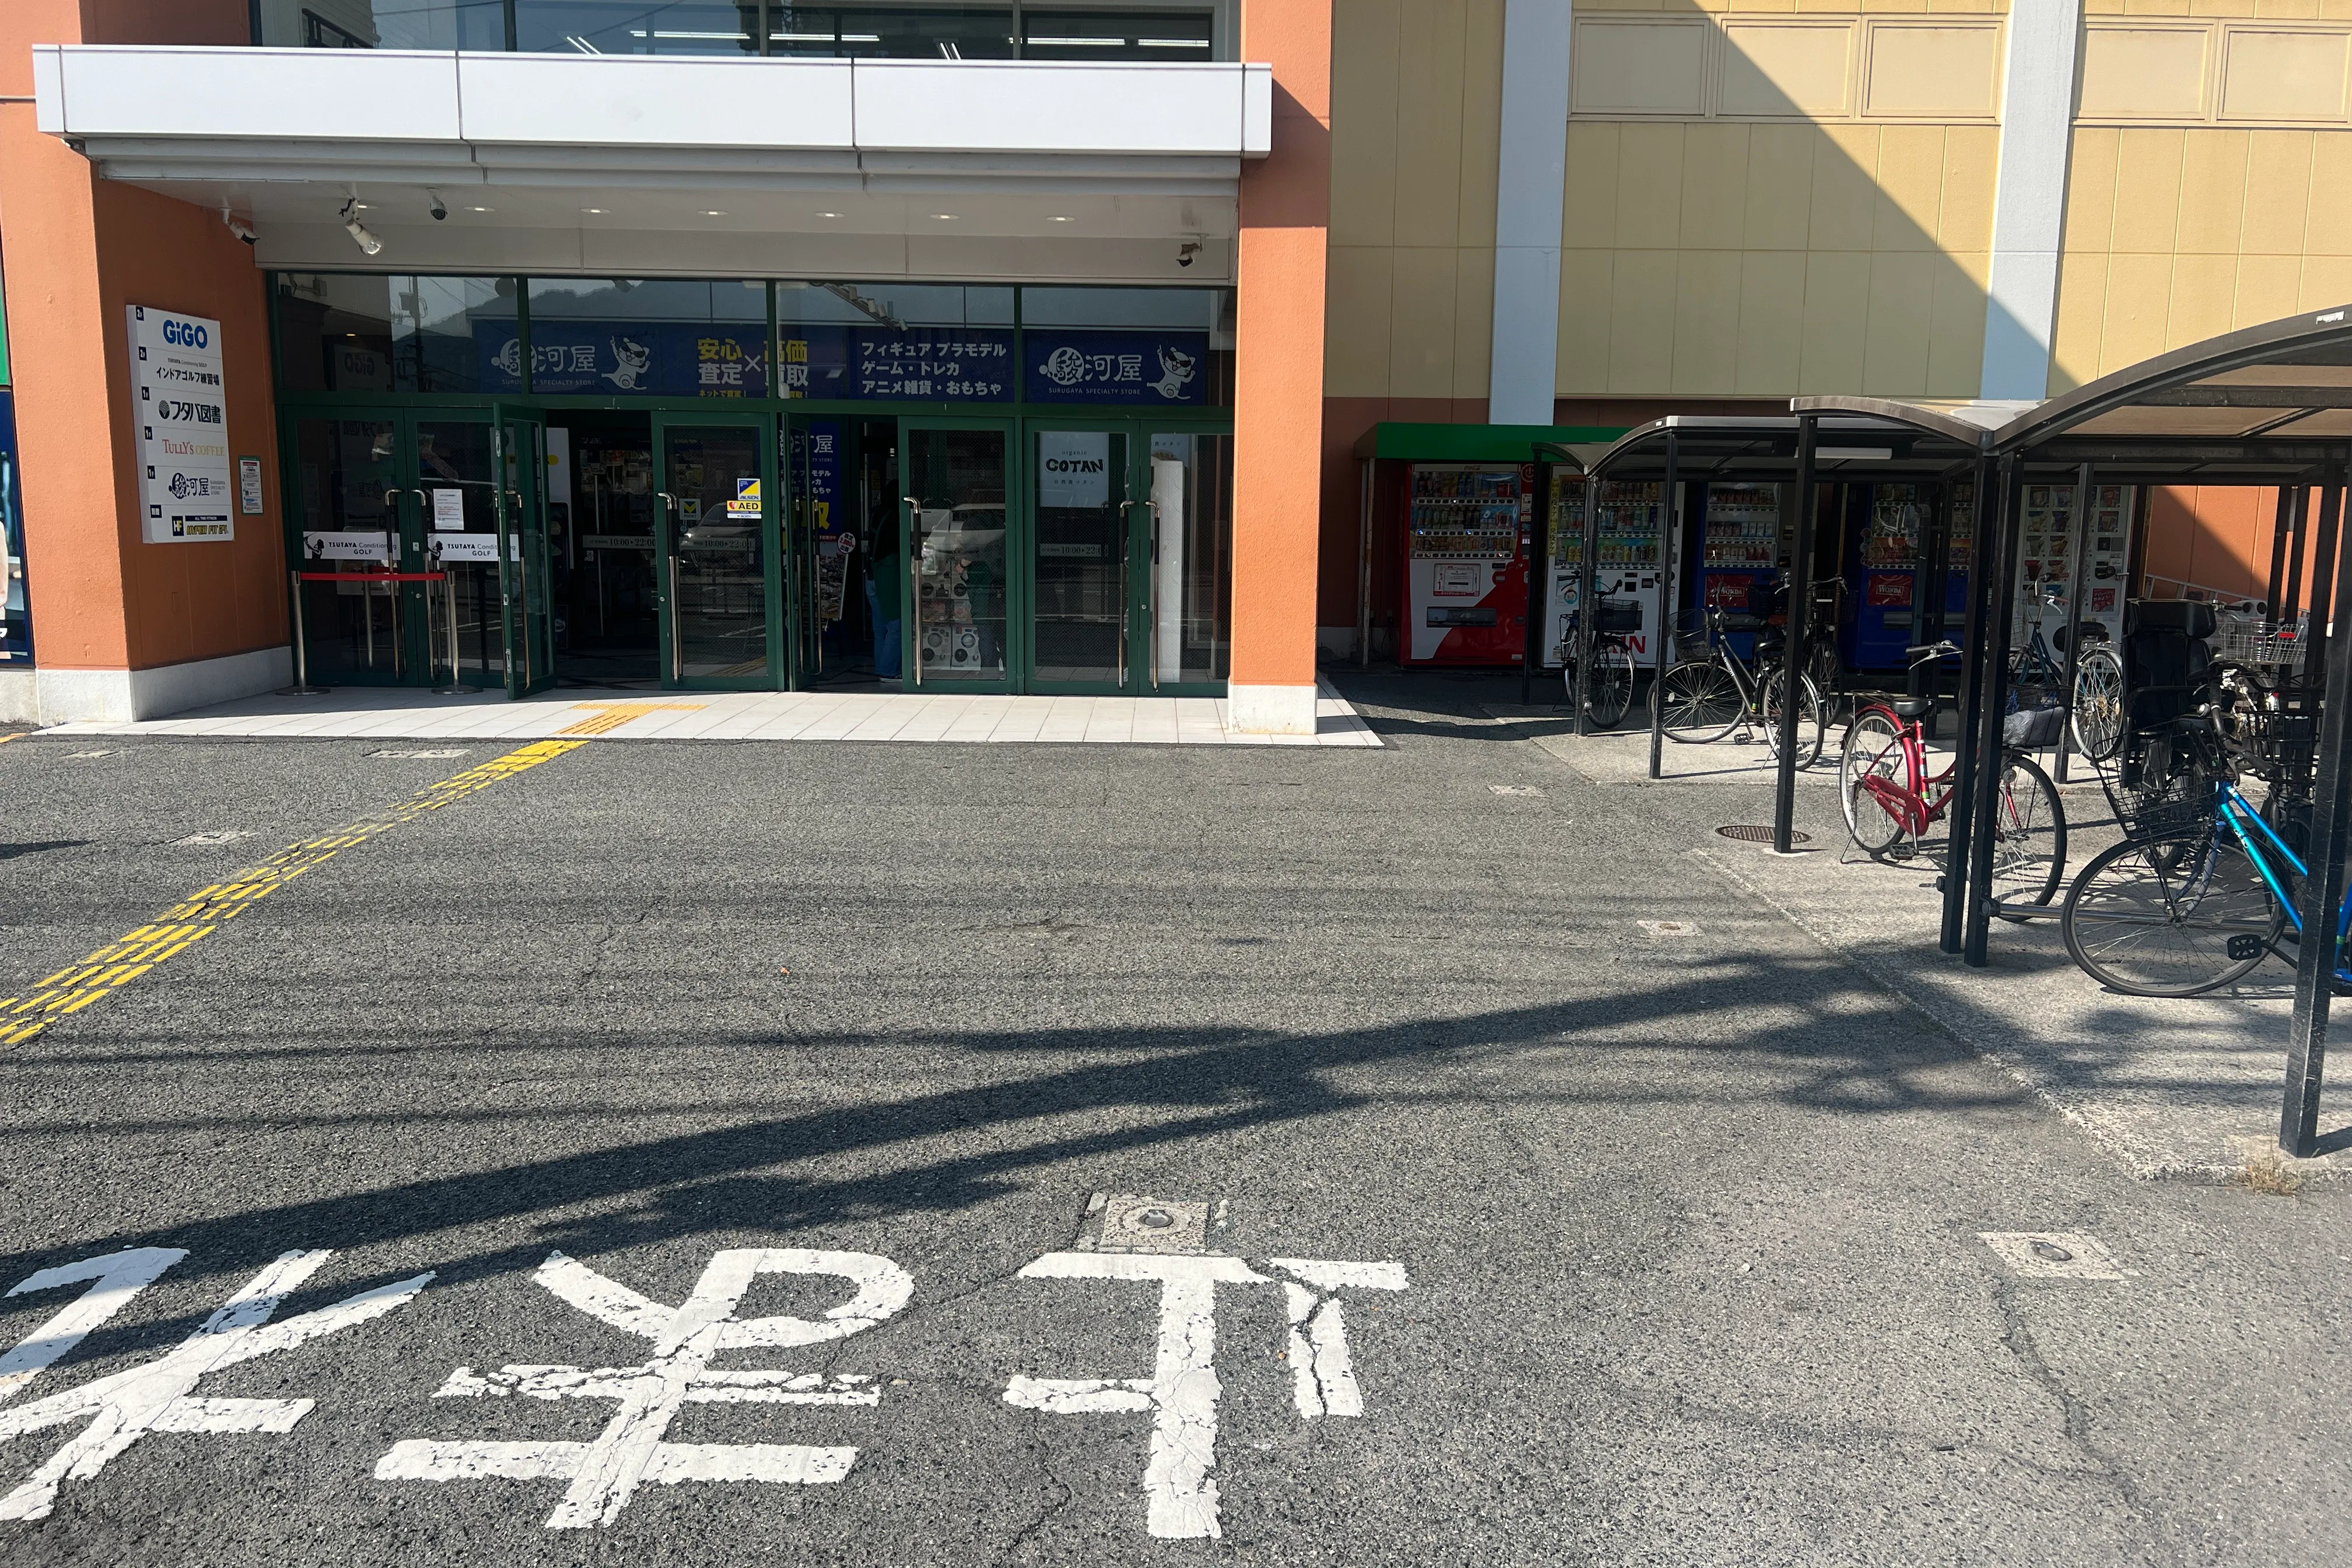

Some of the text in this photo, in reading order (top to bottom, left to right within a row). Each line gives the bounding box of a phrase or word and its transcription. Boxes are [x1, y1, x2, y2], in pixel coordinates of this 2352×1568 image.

[163, 320, 208, 349] GiGO
[698, 338, 742, 360] 安心
[862, 342, 1007, 357] フィギュア プラモデル
[698, 362, 743, 385] 査定
[862, 361, 960, 376] ゲーム・トレカ
[1048, 347, 1142, 385] 駿河屋
[156, 367, 219, 386] インドアゴルフ練習場
[862, 380, 1002, 396] アニメ雑貨・おもちゃ
[170, 401, 221, 424] フタバ図書
[195, 445, 225, 456] COFFEE
[1046, 459, 1104, 473] COTAN
[172, 473, 209, 499] 駿河屋
[1878, 586, 1902, 594] WONDA
